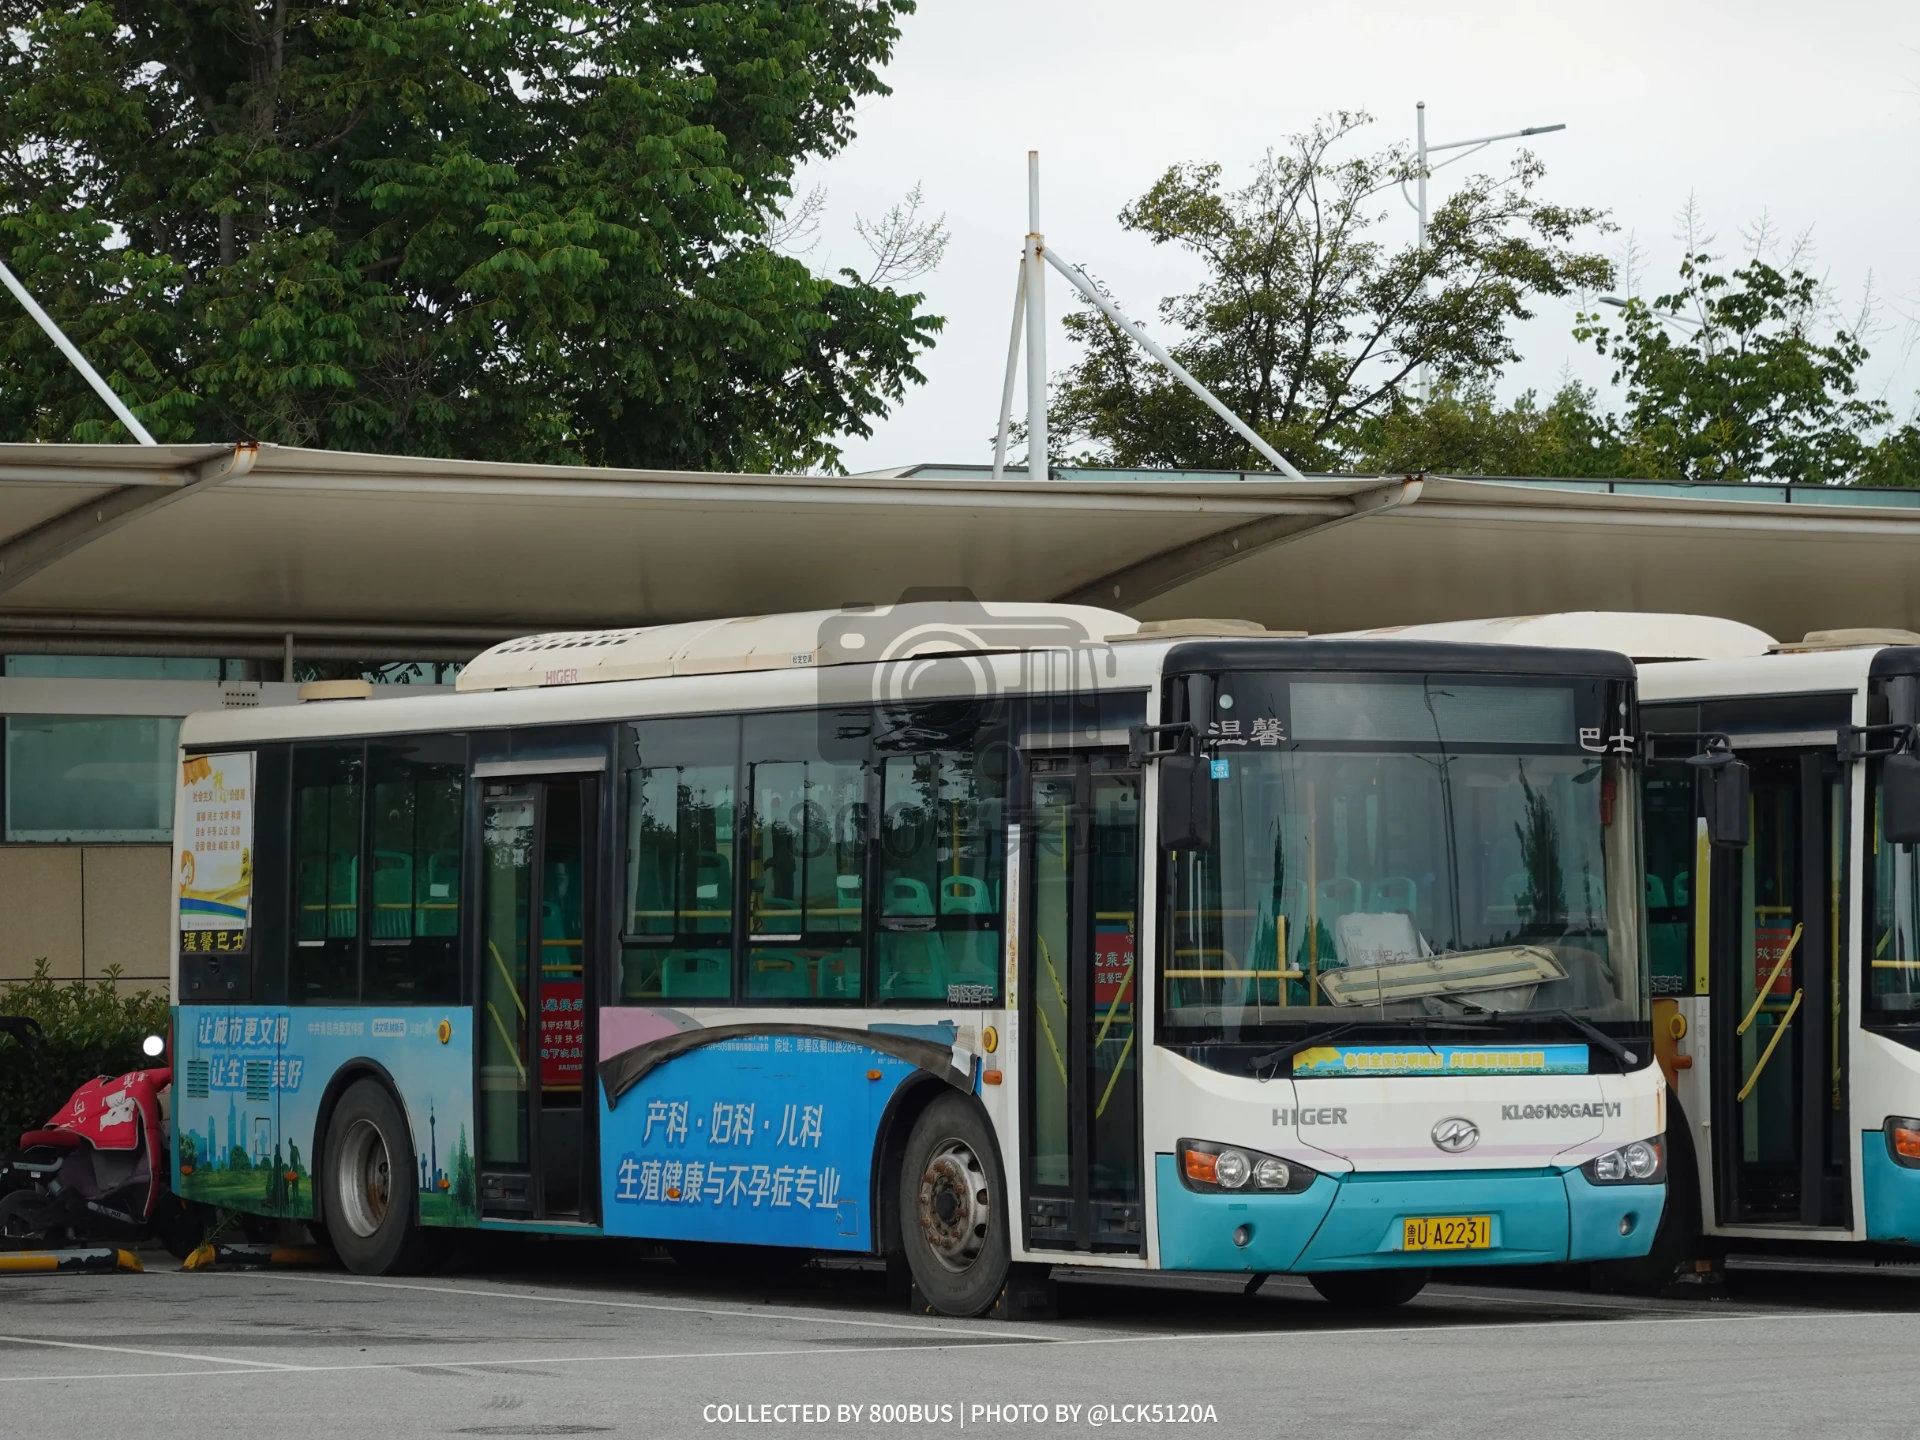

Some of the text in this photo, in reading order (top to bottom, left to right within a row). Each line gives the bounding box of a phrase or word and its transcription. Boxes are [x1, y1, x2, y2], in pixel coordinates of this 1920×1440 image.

[792, 654, 813, 664] 松芝空调
[545, 668, 578, 685] HIGER
[1208, 717, 1635, 753] 温馨 巴士
[1213, 770, 1228, 778] 2024
[183, 931, 244, 951] 温馨巴士
[947, 984, 994, 1004] 海格客车
[541, 998, 583, 1012] 馨提示
[199, 1016, 290, 1045] 让城市更文明
[211, 1059, 303, 1089] 让生美好
[1271, 1101, 1621, 1126] HIGER KLQ6109GAEV1
[616, 1158, 841, 1209] 生殖健康与不孕症专业
